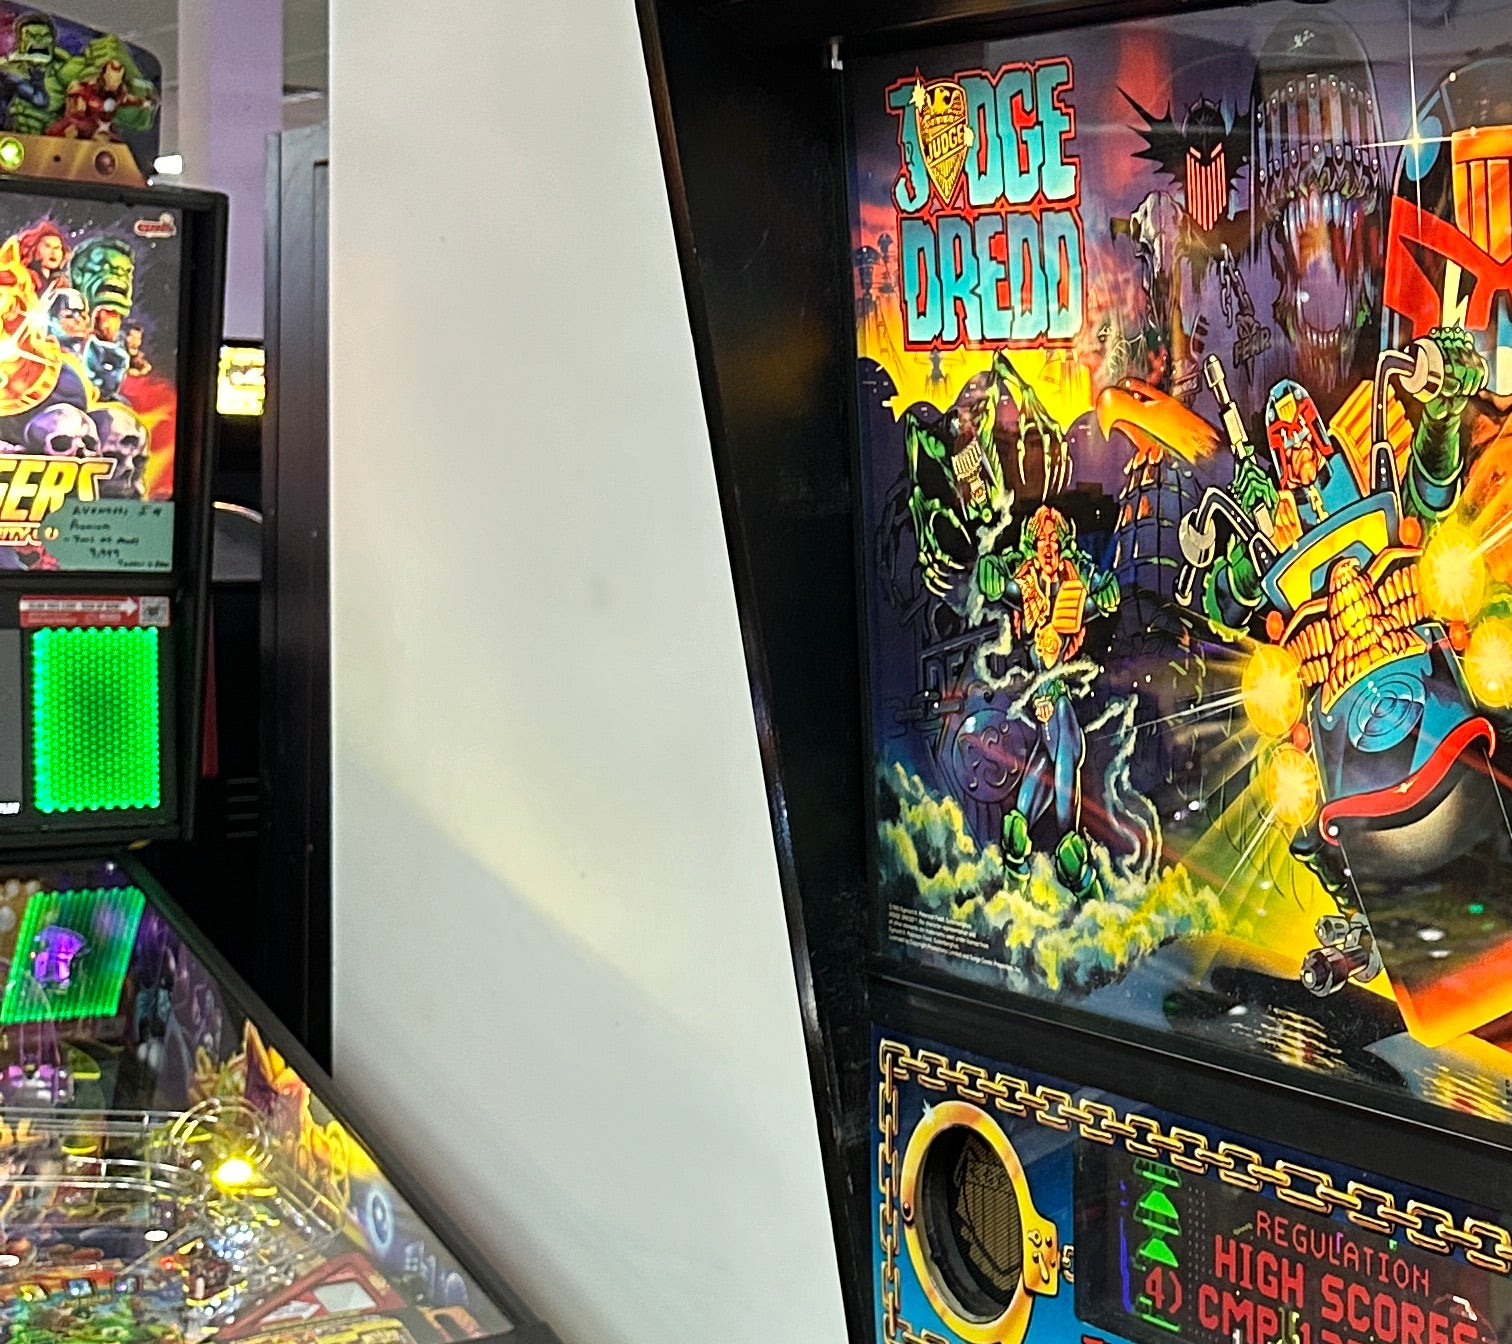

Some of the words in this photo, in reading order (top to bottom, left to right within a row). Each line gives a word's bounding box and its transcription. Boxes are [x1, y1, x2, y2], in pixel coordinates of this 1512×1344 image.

[899, 209, 1086, 348] DREDD
[1145, 1267, 1182, 1314] 4)
[1214, 1235, 1305, 1308] HIGH
[1256, 1209, 1430, 1296] REGULATION
